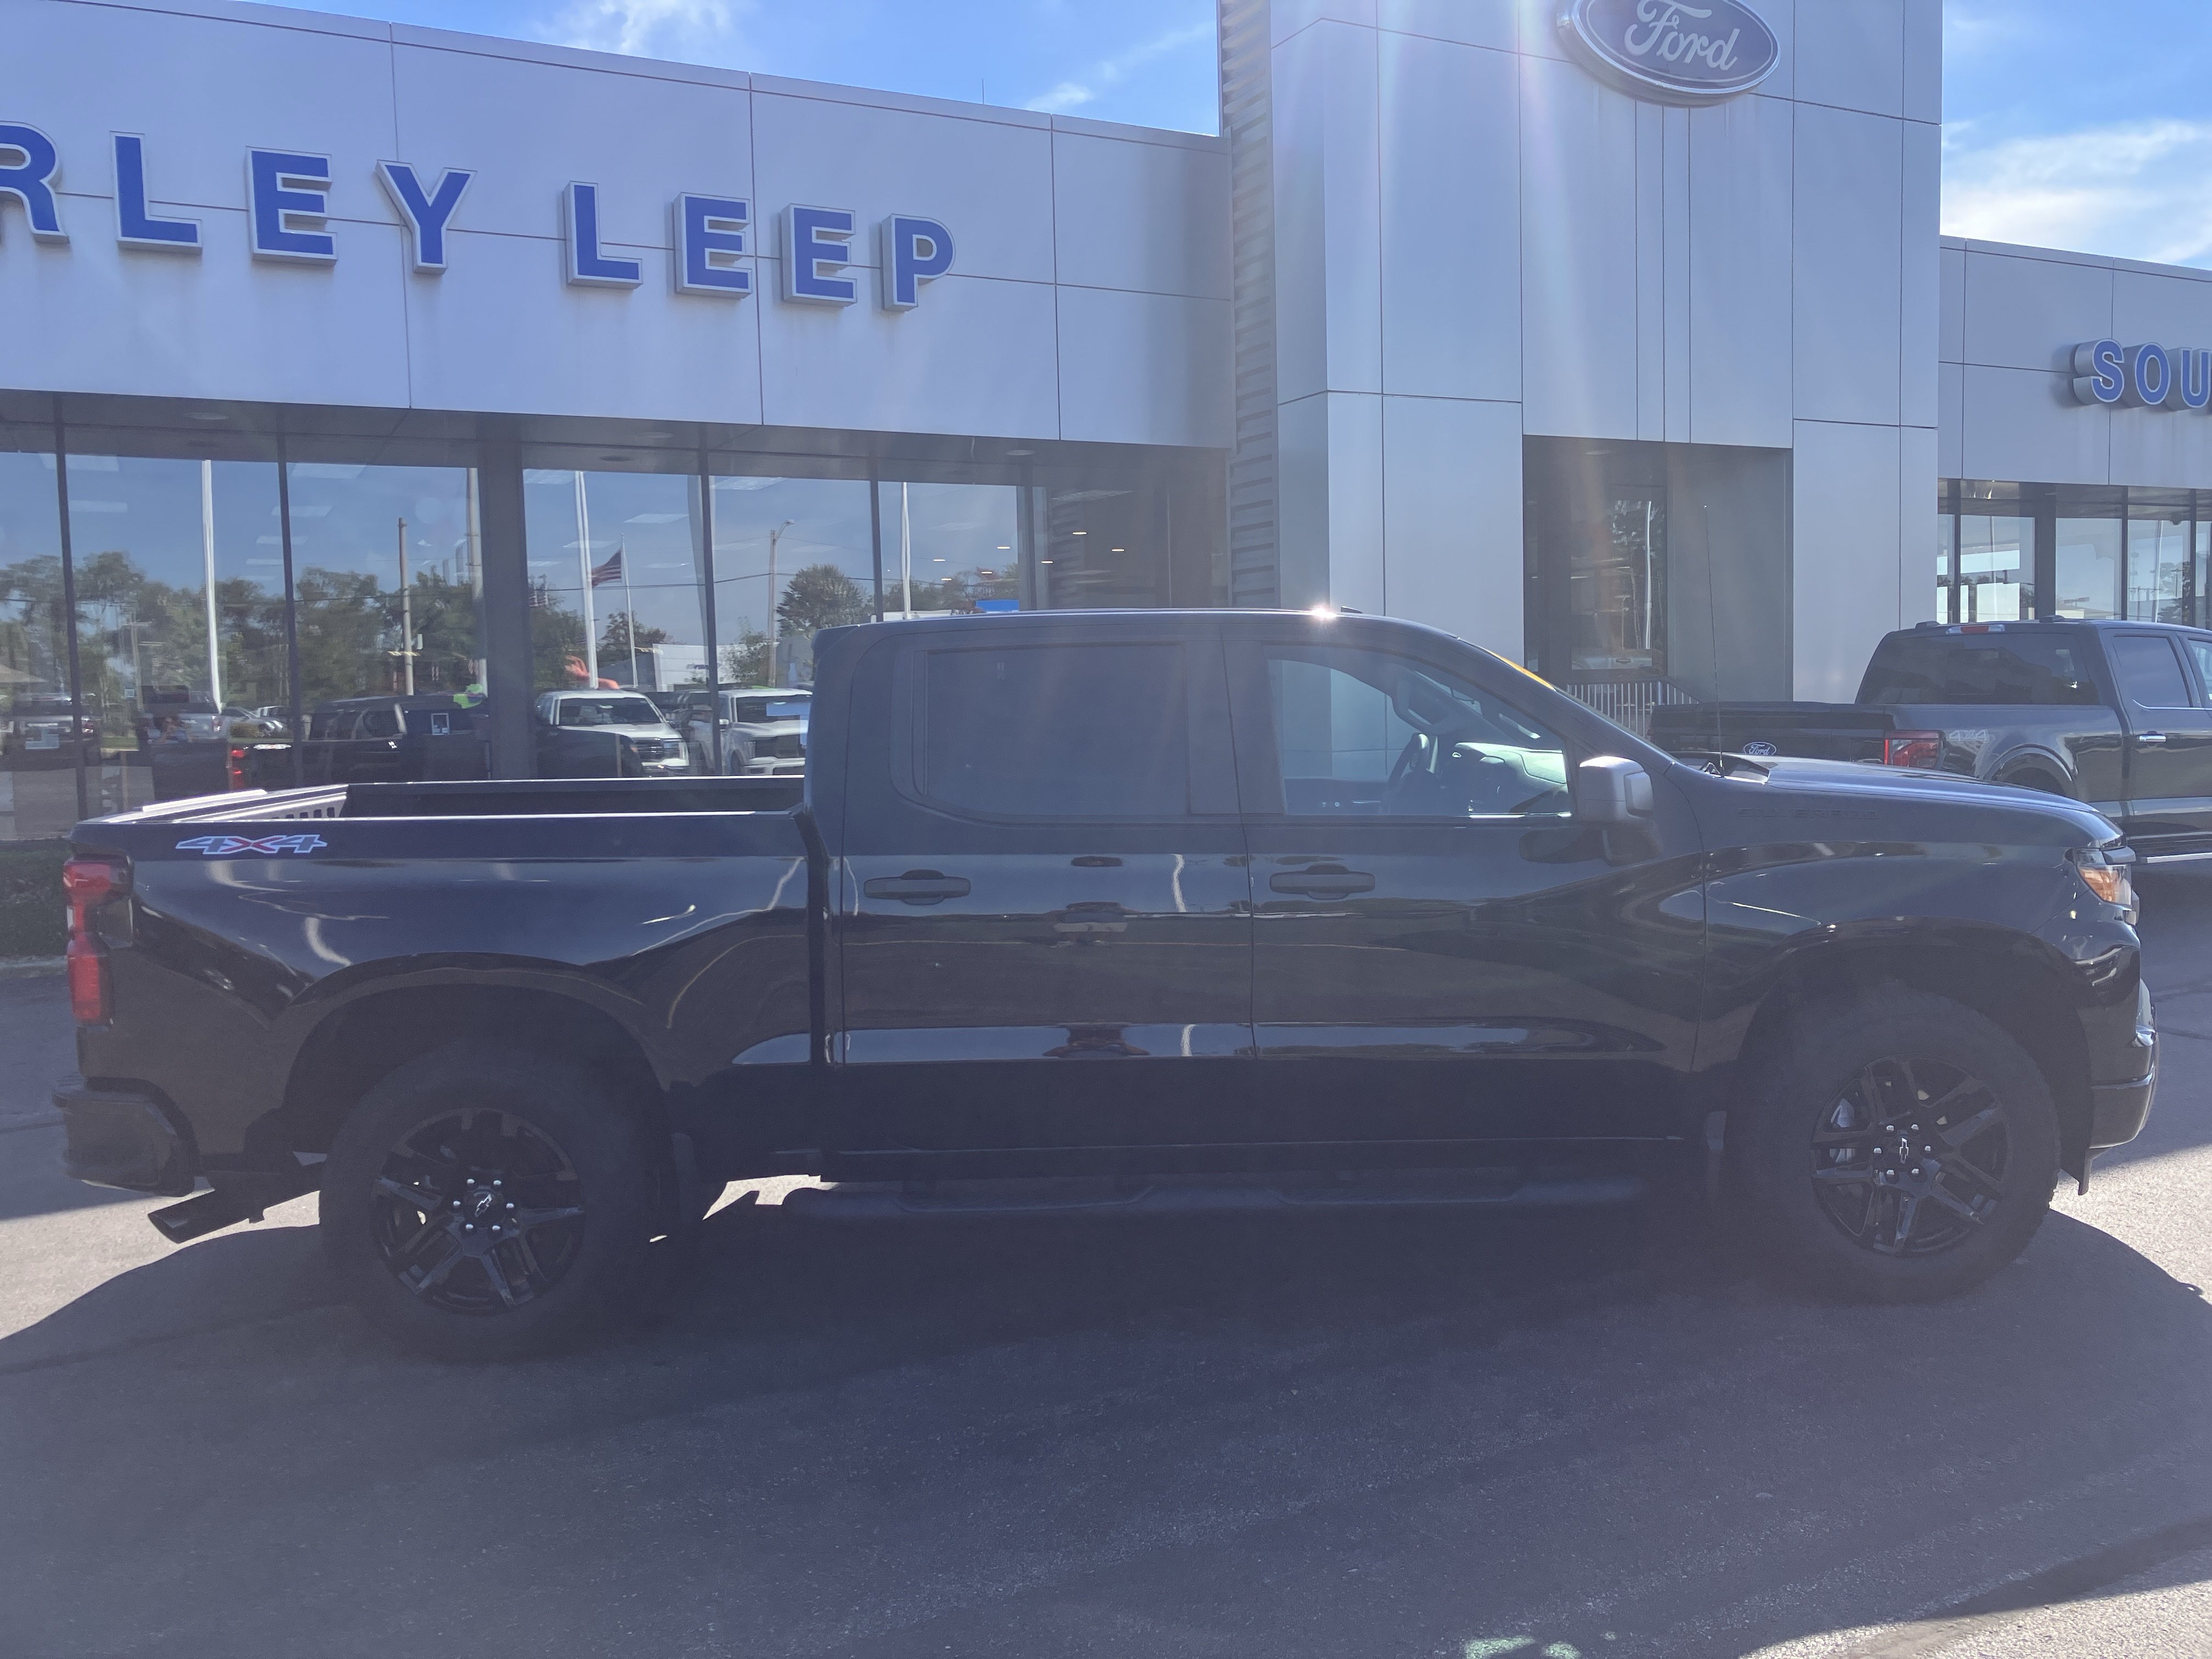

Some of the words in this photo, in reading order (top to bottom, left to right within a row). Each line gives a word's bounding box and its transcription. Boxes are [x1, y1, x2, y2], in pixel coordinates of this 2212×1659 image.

[1624, 0, 1740, 71] Ford
[0, 121, 477, 274] RLEY
[563, 180, 956, 311] LEEP
[2075, 338, 2211, 410] SOU
[1749, 743, 1771, 755] Ford
